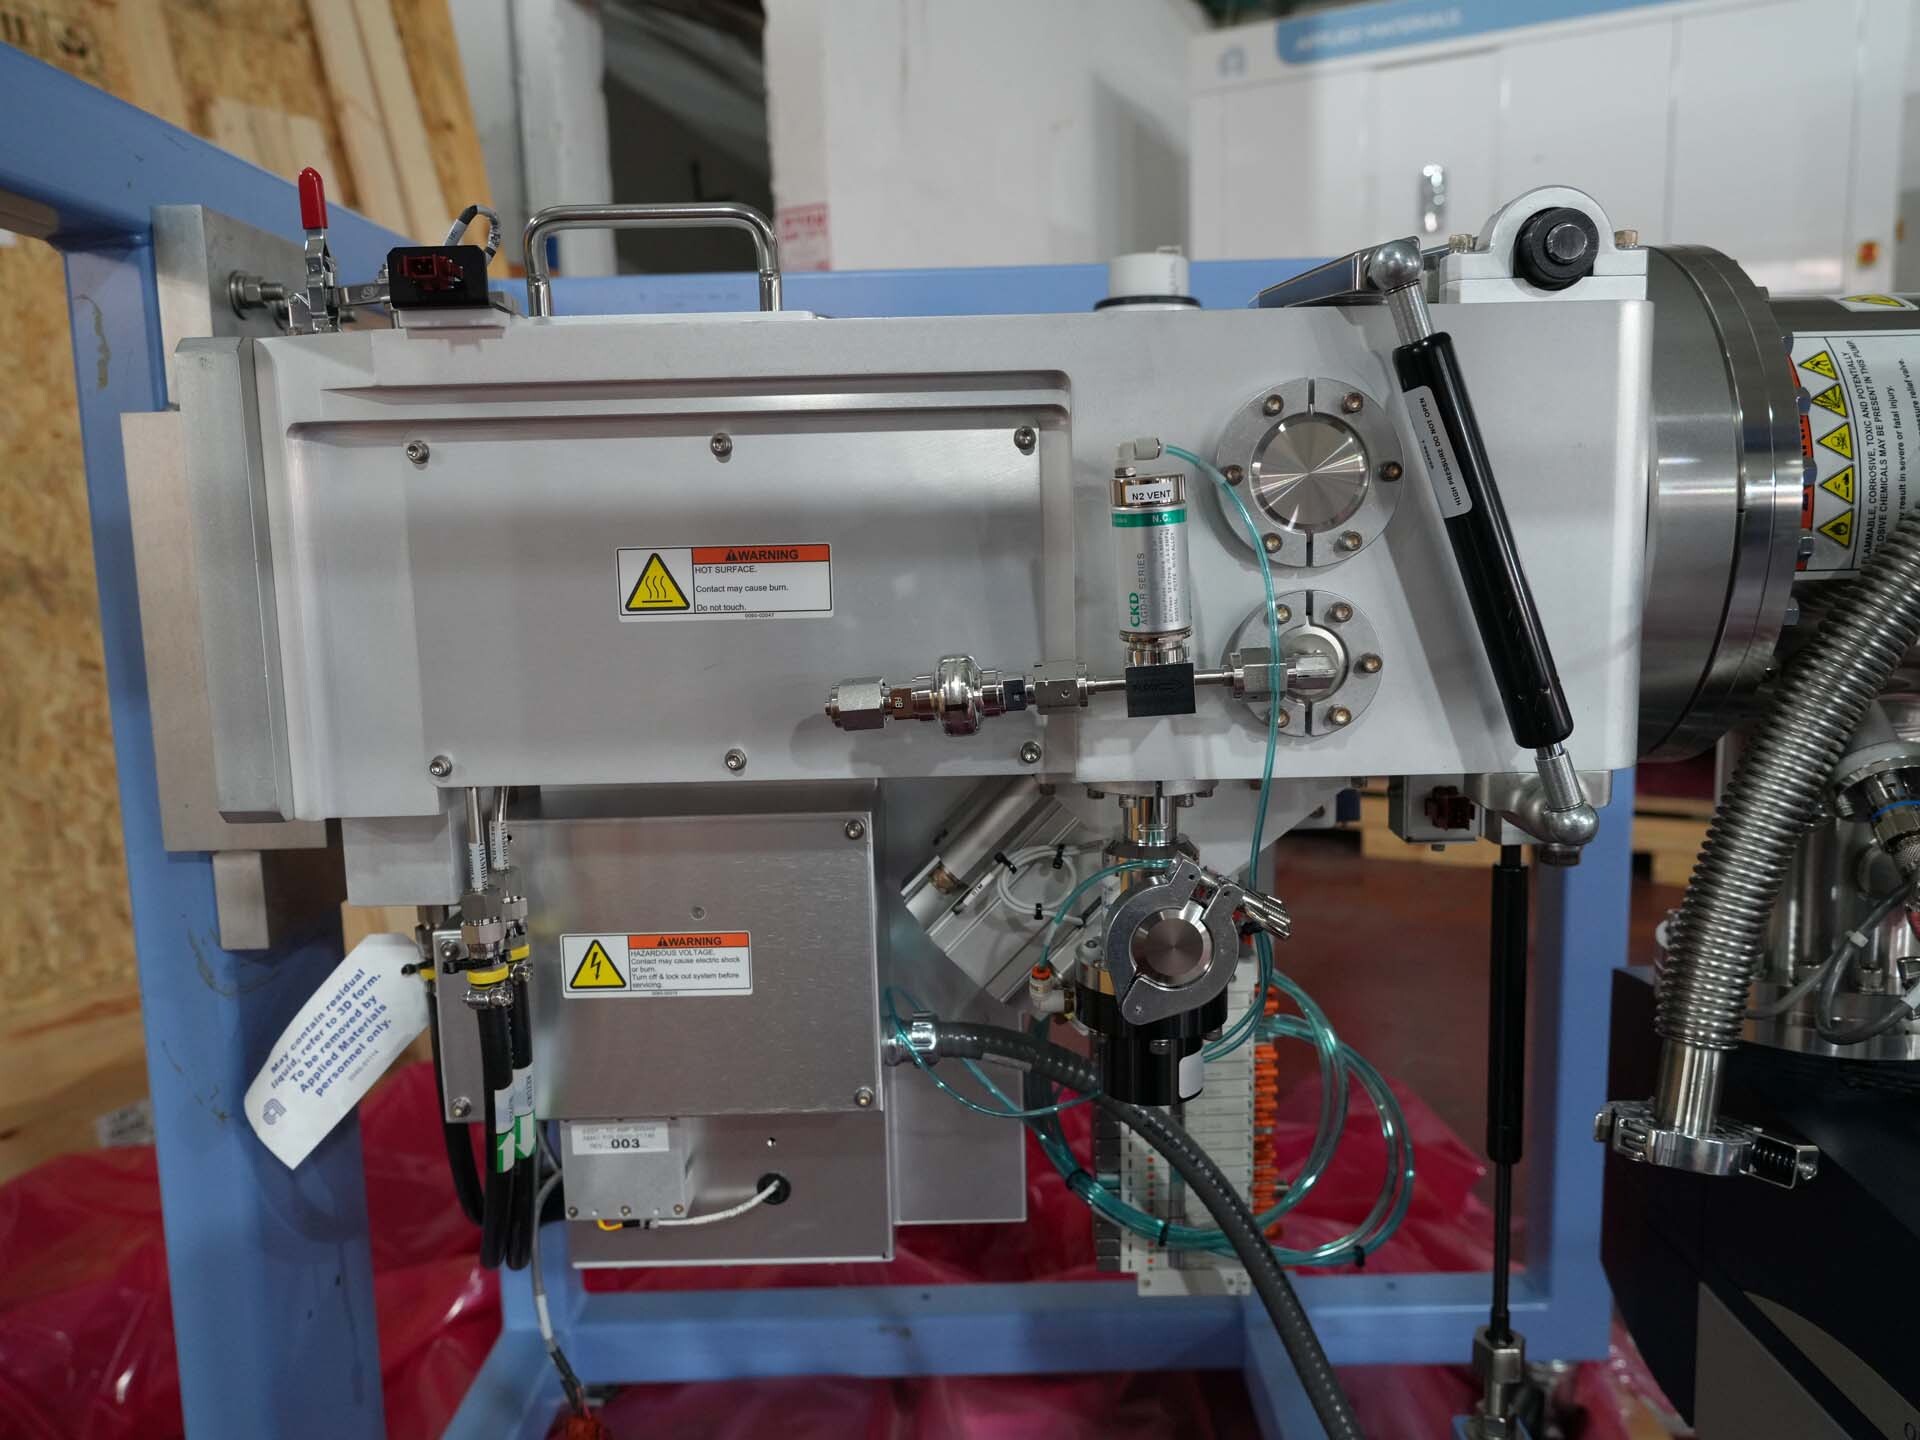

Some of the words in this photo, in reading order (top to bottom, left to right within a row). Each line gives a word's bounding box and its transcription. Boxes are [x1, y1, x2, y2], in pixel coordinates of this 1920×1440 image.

[1857, 360, 1868, 375] THIS
[1842, 352, 1866, 400] POTENTIALLY
[1864, 376, 1873, 384] IN
[1419, 398, 1430, 418] OPEN
[1860, 402, 1871, 418] AND
[1867, 386, 1882, 424] PRESENT
[1427, 420, 1436, 434] NOT
[1892, 410, 1902, 428] fatal
[1864, 420, 1874, 446] TOXIC
[1875, 425, 1885, 436] BE
[1896, 430, 1904, 440] or
[1432, 436, 1440, 447] DO
[1878, 440, 1886, 456] MAY
[1898, 442, 1906, 469] severe
[1438, 448, 1454, 486] PRESSURE
[1868, 448, 1878, 504] CORROSIVE,
[1898, 474, 1906, 482] in
[1879, 459, 1888, 512] CHEMICALS
[1132, 492, 1144, 500] N2
[1147, 490, 1171, 500] VENT
[1451, 487, 1462, 506] HIGH
[1898, 484, 1906, 509] result
[1152, 513, 1172, 523] N.C.
[738, 549, 799, 561] WARNING
[695, 566, 712, 574] HOT
[714, 565, 758, 574] SURFACE.
[1137, 552, 1145, 589] SERIES
[696, 585, 725, 594] Contact
[726, 586, 744, 594] may
[744, 584, 768, 592] cause
[769, 584, 789, 592] burn.
[696, 604, 708, 612] Do
[709, 604, 722, 612] not
[723, 603, 747, 612] touch.
[1130, 592, 1140, 628] CKD
[668, 936, 722, 947] WARNING
[630, 950, 677, 958] HAZARDOUS
[658, 958, 672, 966] may
[692, 973, 718, 981] system
[270, 1051, 289, 1074] May
[290, 1012, 326, 1051] contain
[326, 968, 366, 1012] residual
[270, 1058, 302, 1089] liquid,
[301, 1029, 325, 1056] refer
[325, 1017, 338, 1029] to
[337, 1000, 353, 1016] 3D
[352, 974, 382, 1000] form.
[290, 1070, 305, 1084] To
[304, 1055, 319, 1069] be
[320, 1010, 363, 1054] removed
[362, 995, 377, 1010] by
[300, 1052, 339, 1094] Applied
[338, 1004, 388, 1052] Materials
[315, 1043, 366, 1097] personnel
[366, 1019, 392, 1044] only.
[611, 1138, 640, 1150] 003
